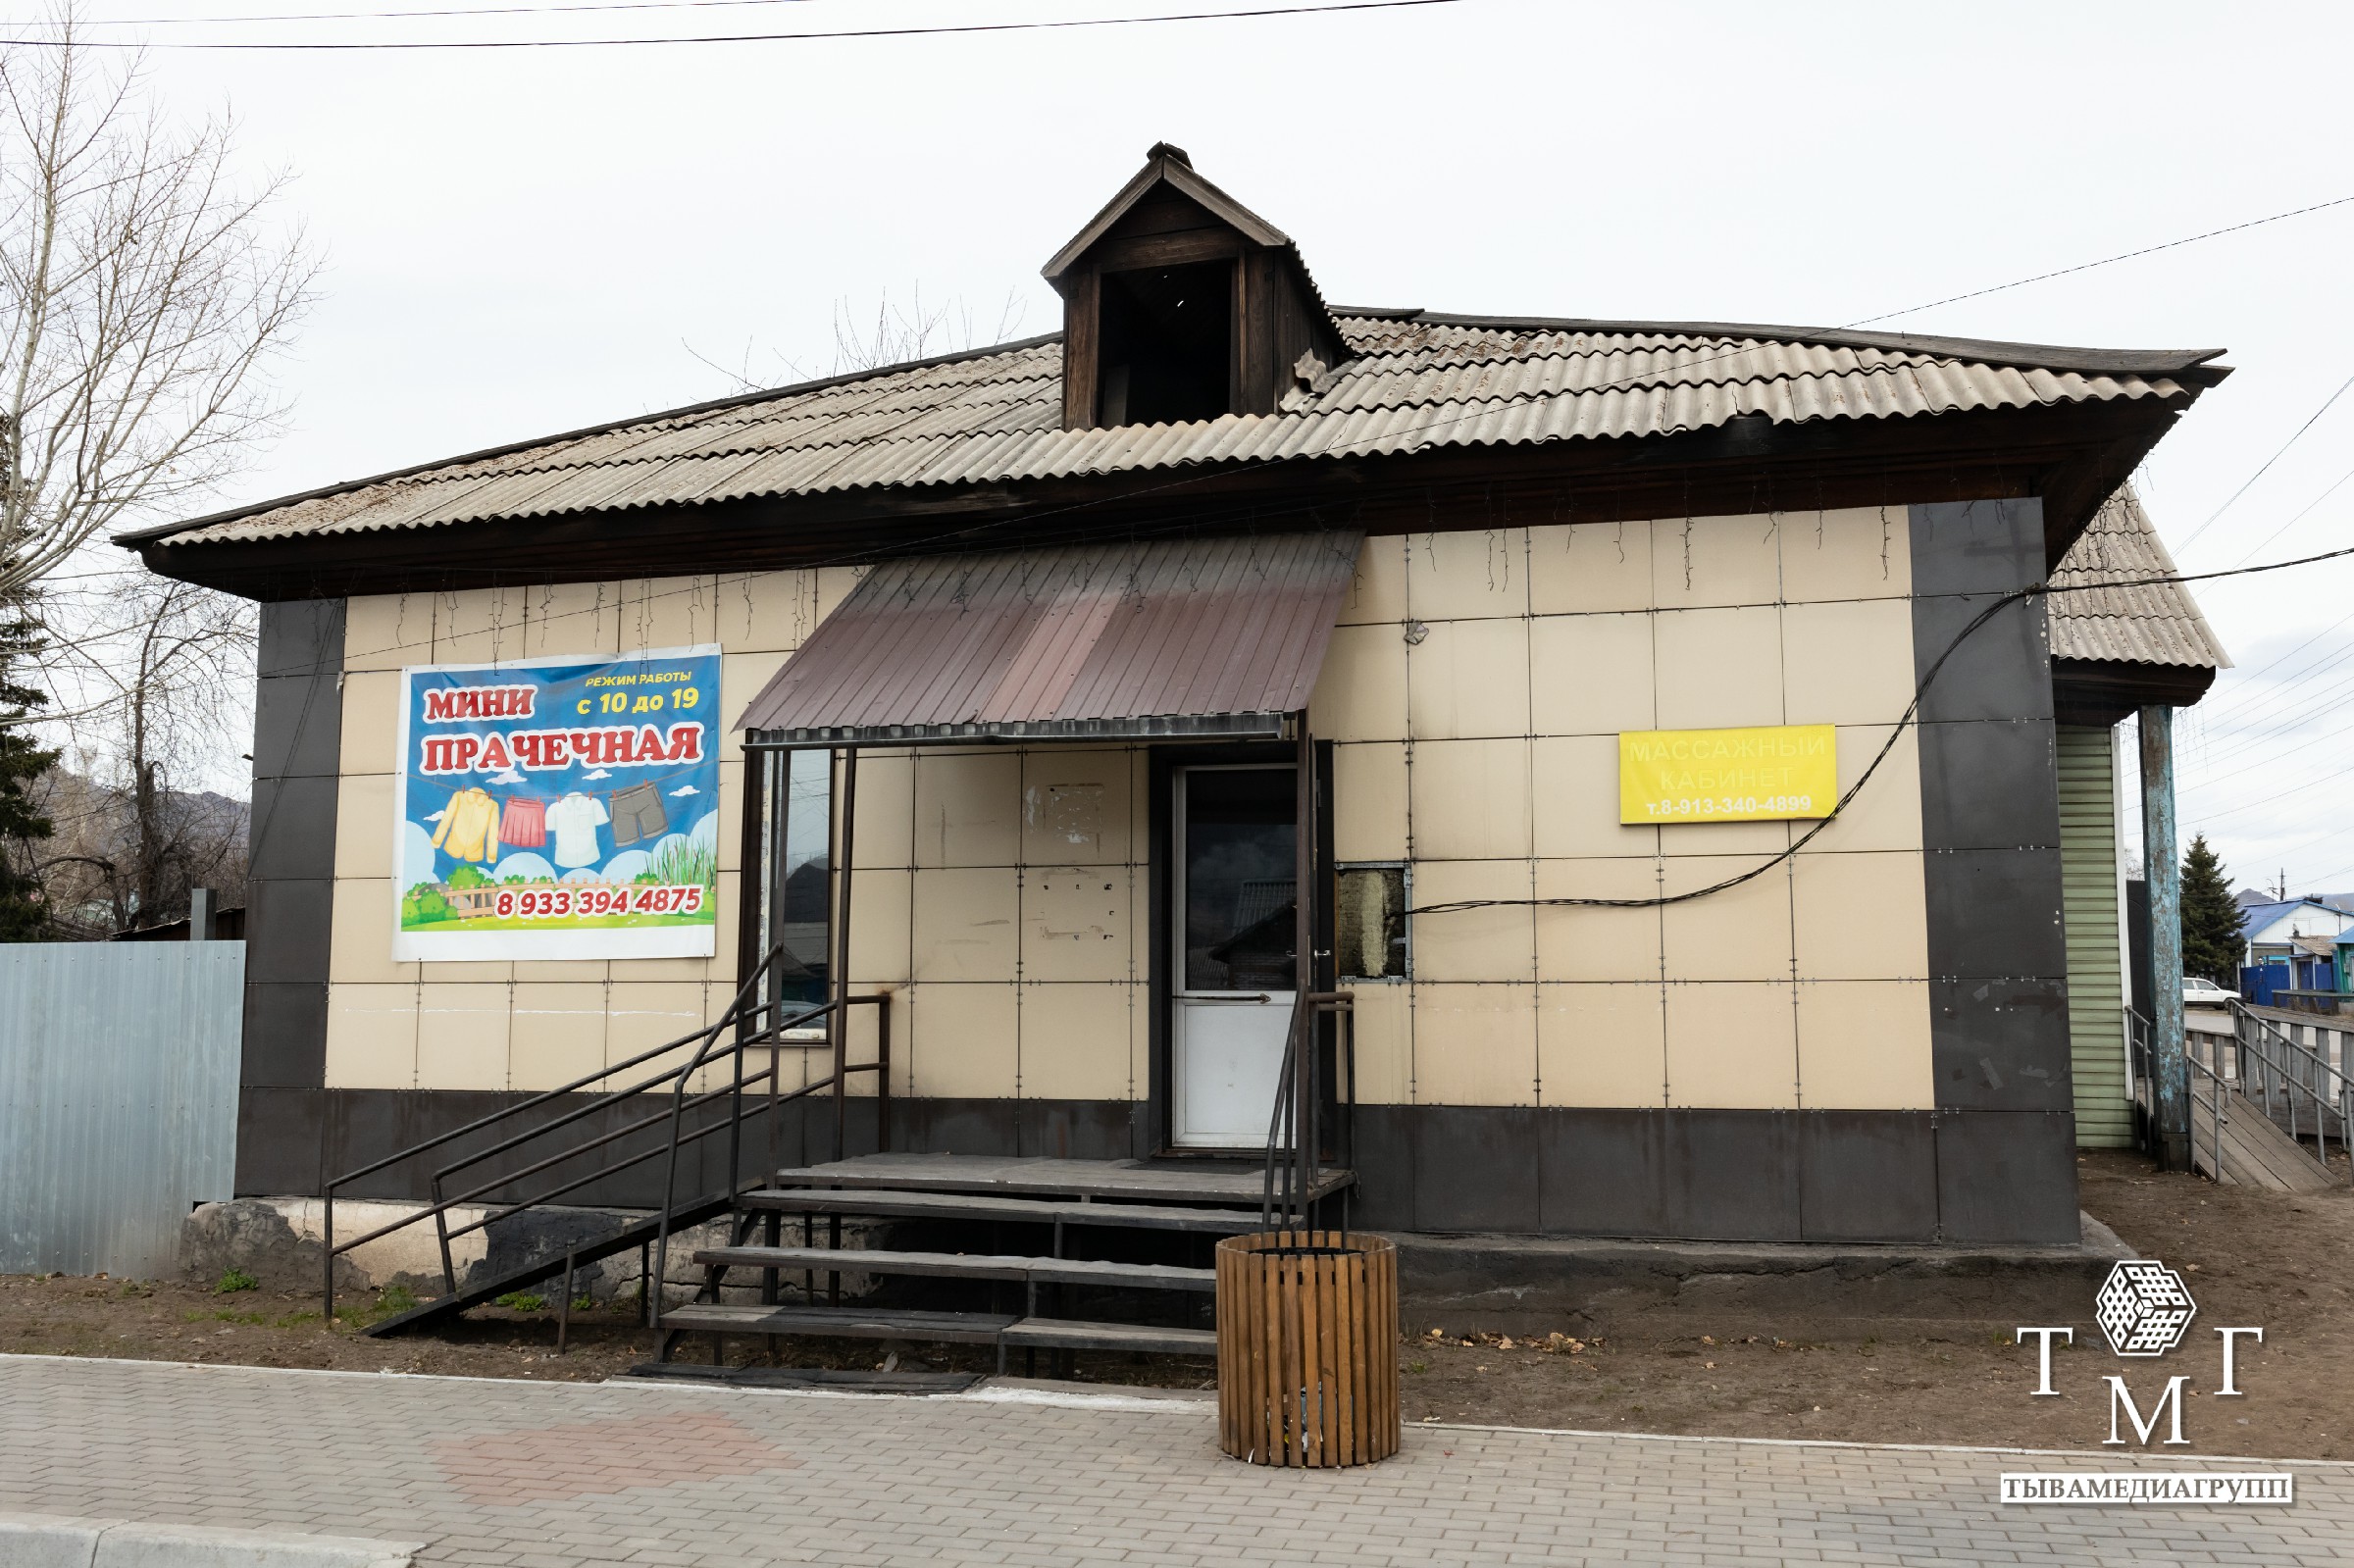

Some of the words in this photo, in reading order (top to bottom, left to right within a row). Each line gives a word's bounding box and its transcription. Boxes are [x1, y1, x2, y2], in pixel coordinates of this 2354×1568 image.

[586, 674, 637, 687] РЕЖИМ
[639, 671, 691, 685] РАБОТЫ
[426, 687, 536, 721] МИНИ
[576, 699, 590, 715] с
[599, 691, 628, 714] 10
[632, 694, 664, 714] до
[671, 686, 699, 709] 19
[424, 726, 702, 772] ПРАЧЕЧНАЯ
[1661, 766, 1796, 790] КАБИНЕТ
[497, 892, 514, 915] 8
[520, 891, 571, 915] 933
[578, 890, 628, 914] 394
[636, 887, 702, 913] 4875
